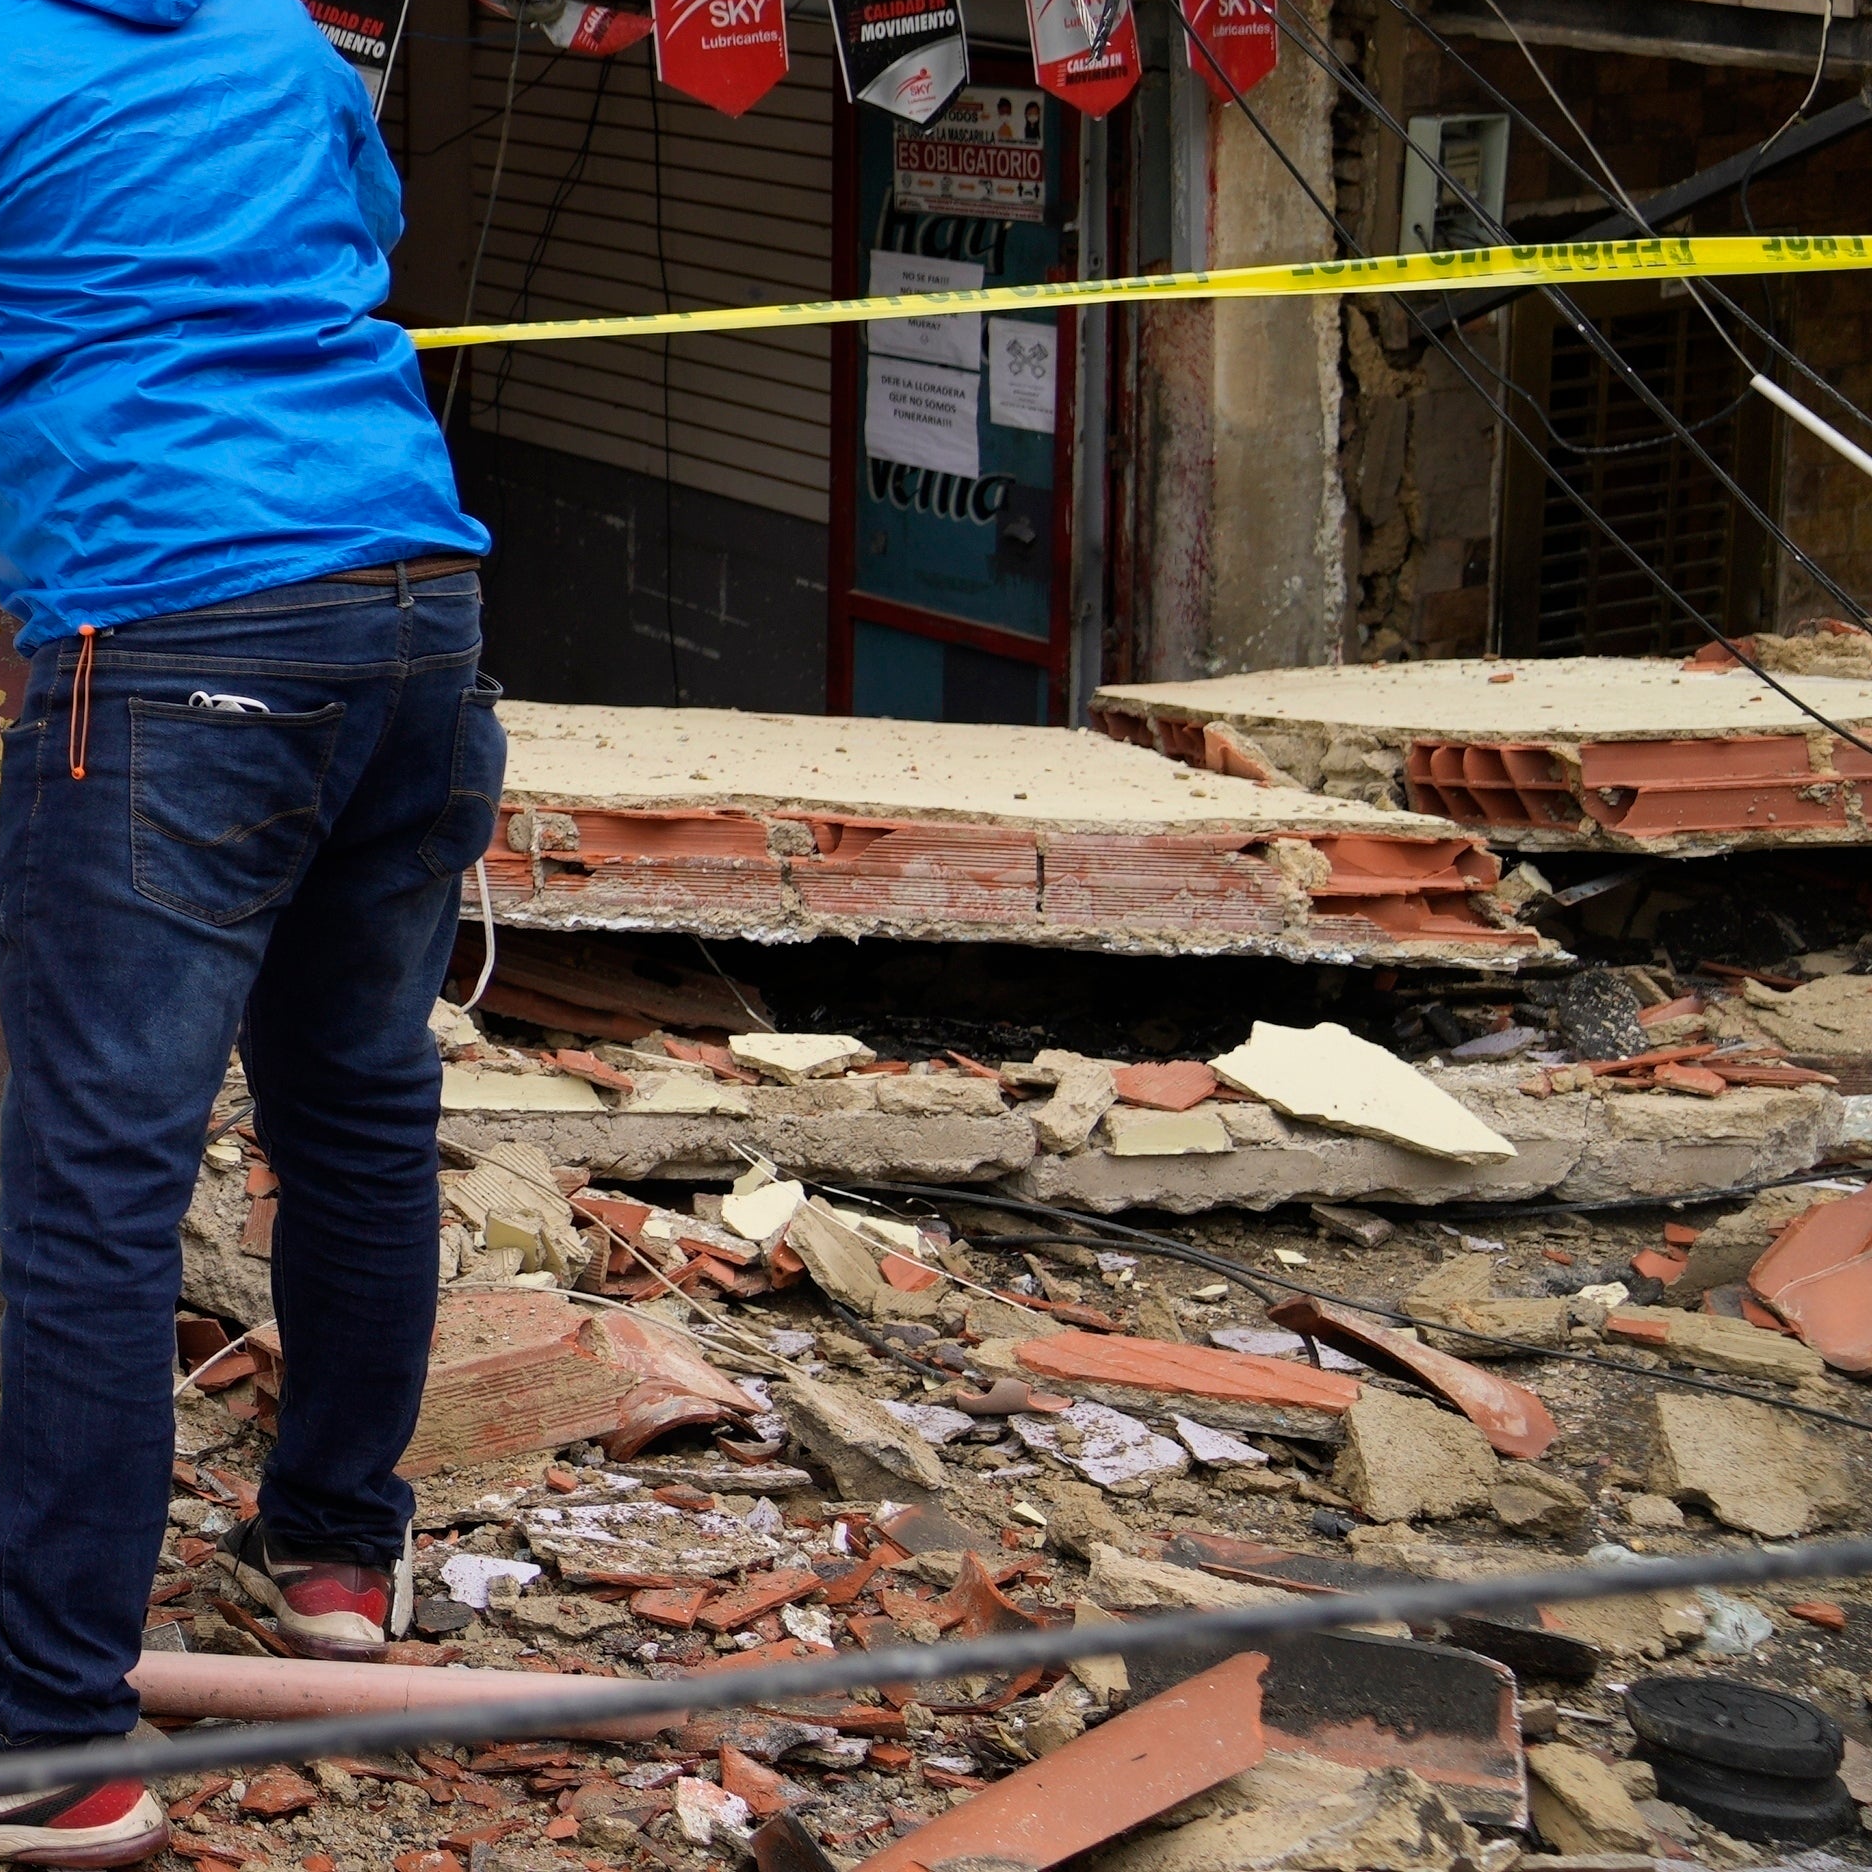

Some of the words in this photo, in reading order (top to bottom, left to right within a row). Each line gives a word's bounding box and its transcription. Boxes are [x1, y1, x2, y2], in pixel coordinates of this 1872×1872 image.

[359, 16, 385, 38] EN
[860, 8, 956, 43] MOVIMIENTO
[701, 28, 778, 50] Lubricantes
[909, 82, 933, 97] SKY
[899, 141, 920, 170] ES
[924, 145, 1041, 179] OBLIGATORIO
